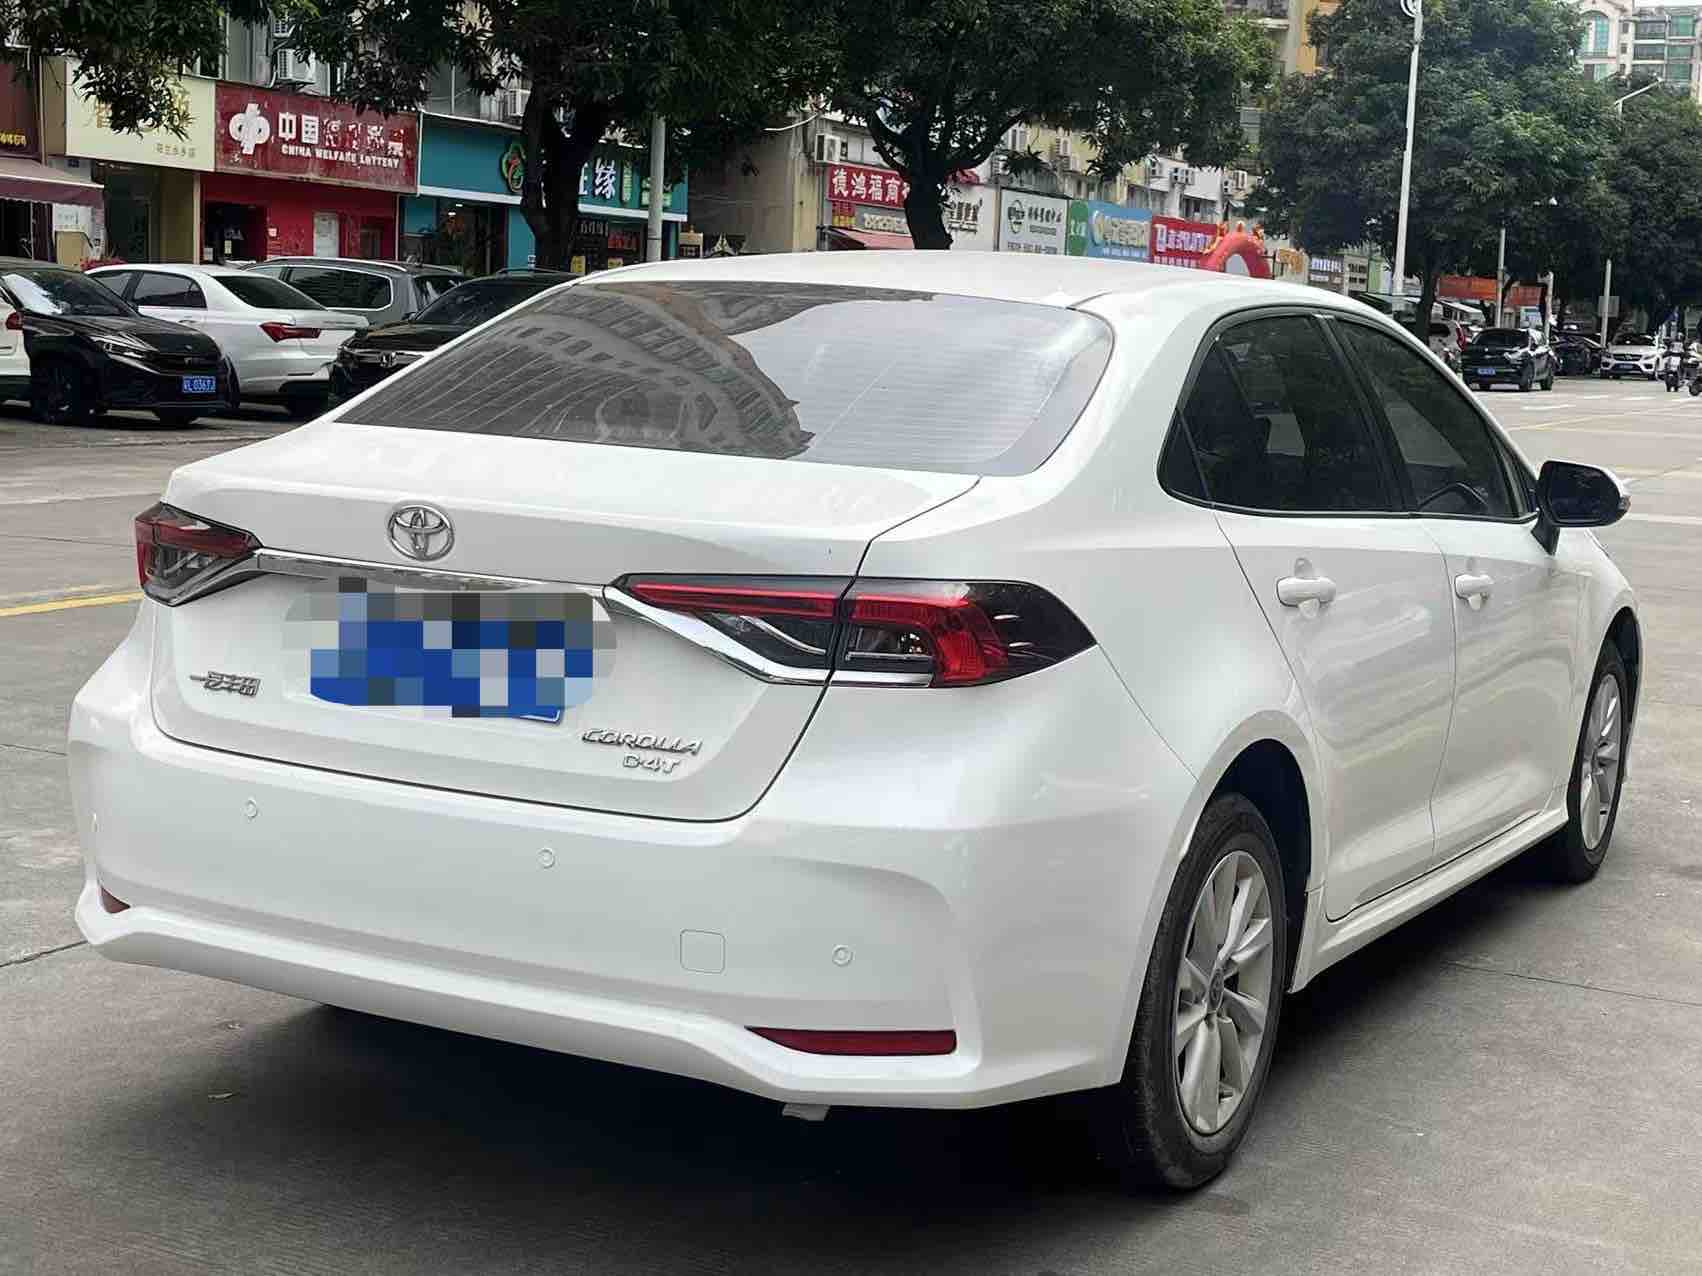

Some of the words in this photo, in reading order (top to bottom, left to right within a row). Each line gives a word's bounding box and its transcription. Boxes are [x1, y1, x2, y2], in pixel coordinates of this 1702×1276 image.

[281, 143, 312, 157] CHINA
[315, 148, 357, 163] WELFARE
[360, 155, 400, 169] LOTTERY
[582, 729, 703, 756] COROLLA
[623, 754, 681, 774] D-4T
